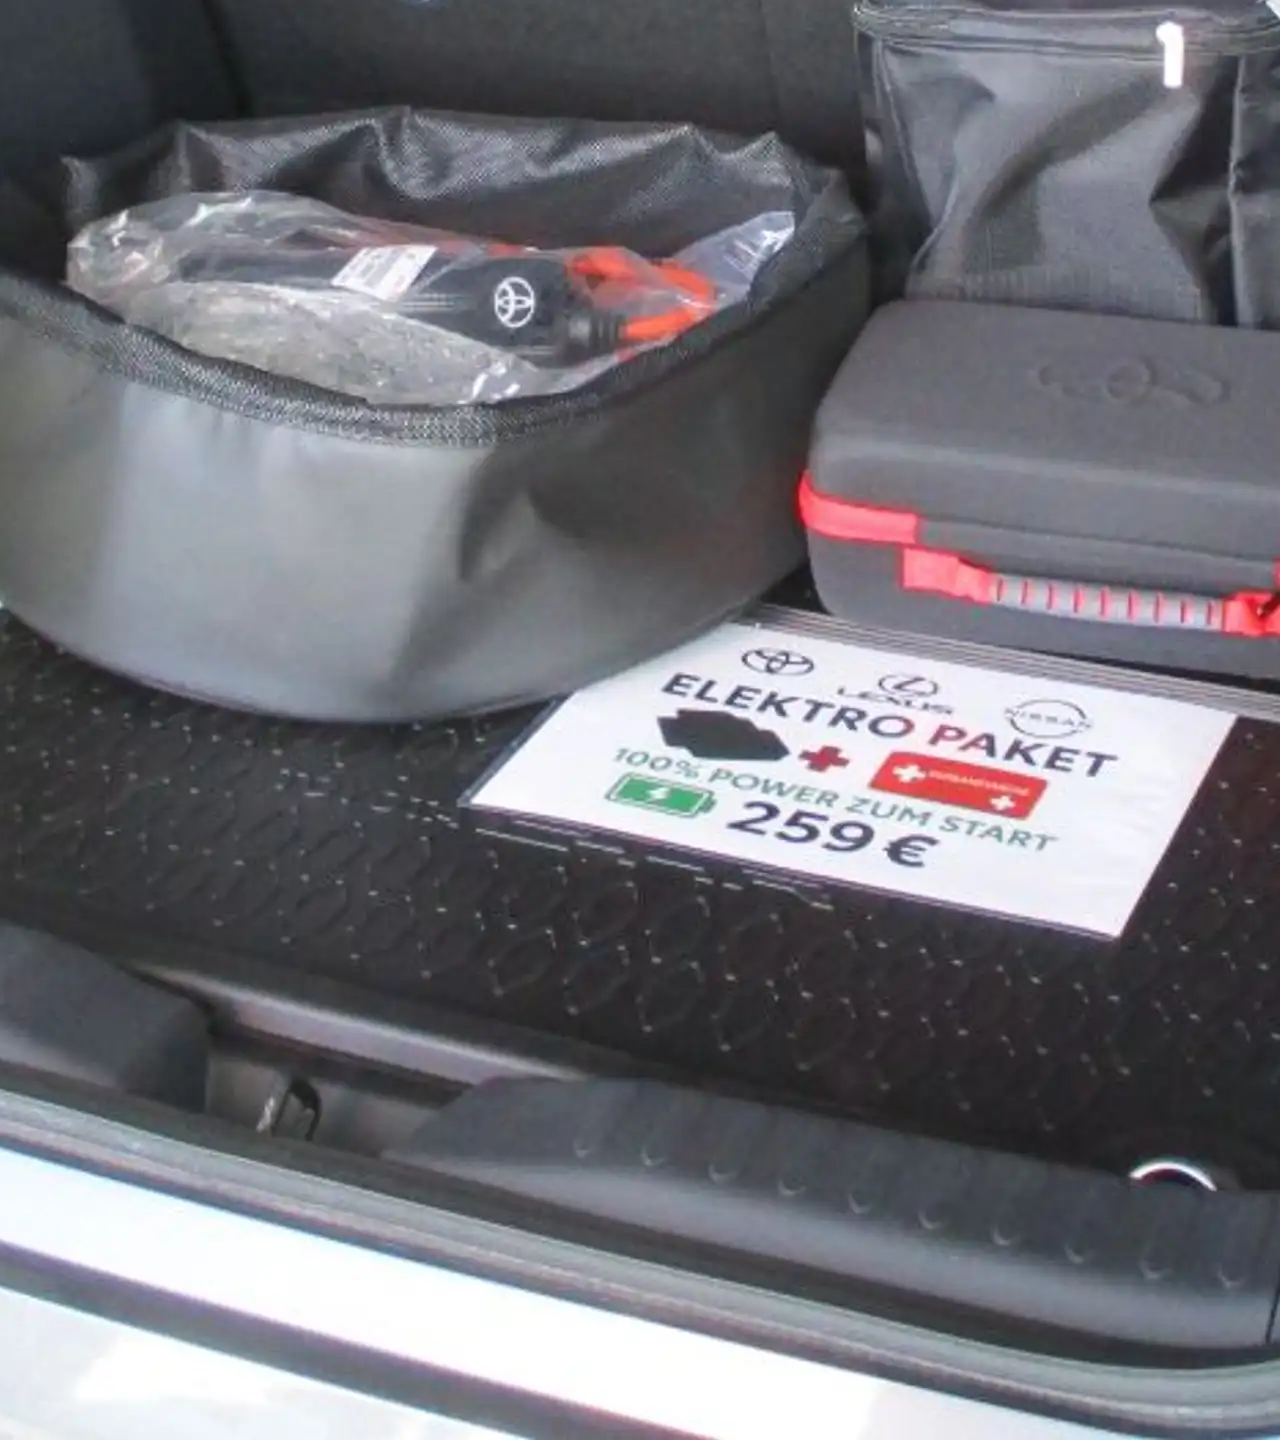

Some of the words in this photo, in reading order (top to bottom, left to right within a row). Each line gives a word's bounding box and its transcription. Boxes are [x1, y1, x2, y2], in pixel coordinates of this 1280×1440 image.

[661, 672, 916, 739] ELEKTRO
[927, 724, 1119, 778] PAKET
[837, 686, 954, 716] LEXUS
[614, 748, 700, 778] 100%
[708, 767, 840, 808] POWER
[844, 795, 933, 827] ZUM
[938, 815, 1060, 852] START
